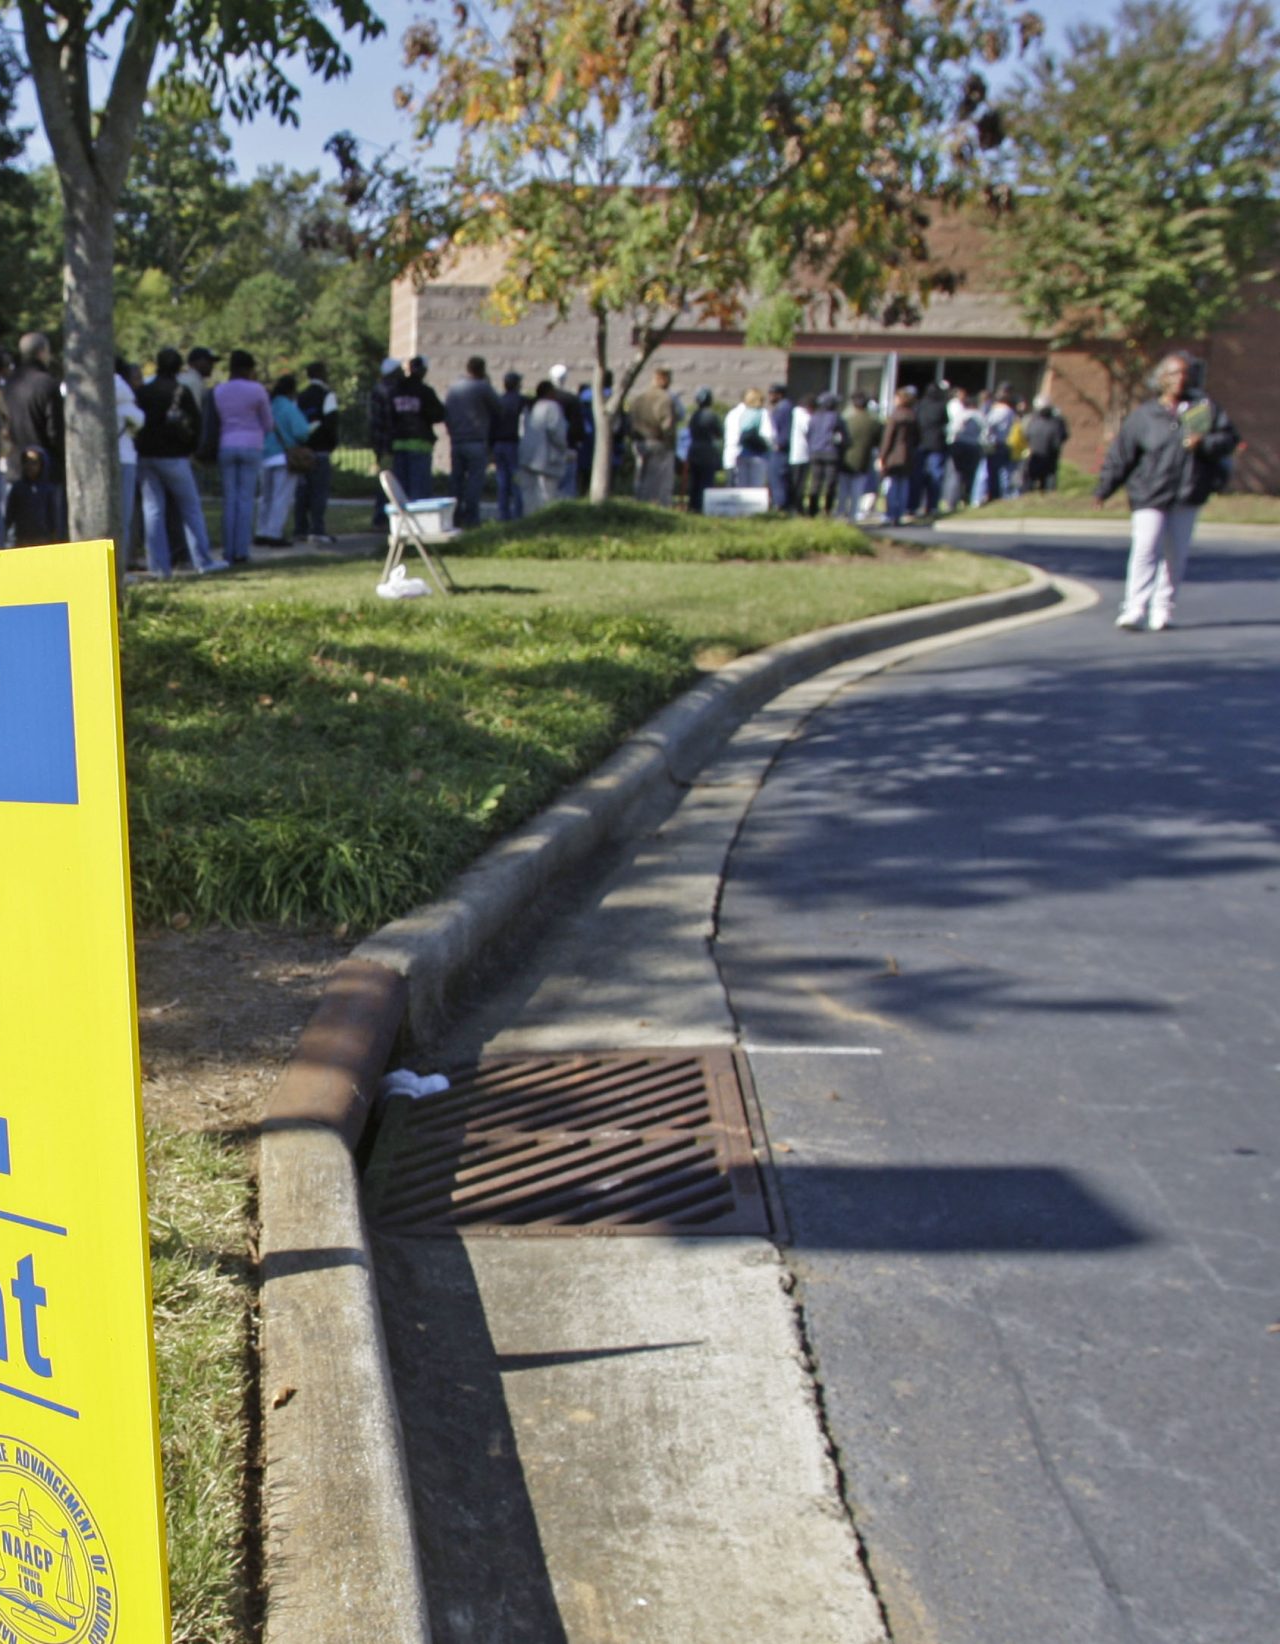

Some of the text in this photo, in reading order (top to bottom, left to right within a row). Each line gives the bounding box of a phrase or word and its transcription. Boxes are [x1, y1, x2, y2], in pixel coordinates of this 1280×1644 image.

[1, 1529, 54, 1573] NAACP
[14, 1446, 97, 1542] ADVANCEMENT
[90, 1553, 108, 1576] OF
